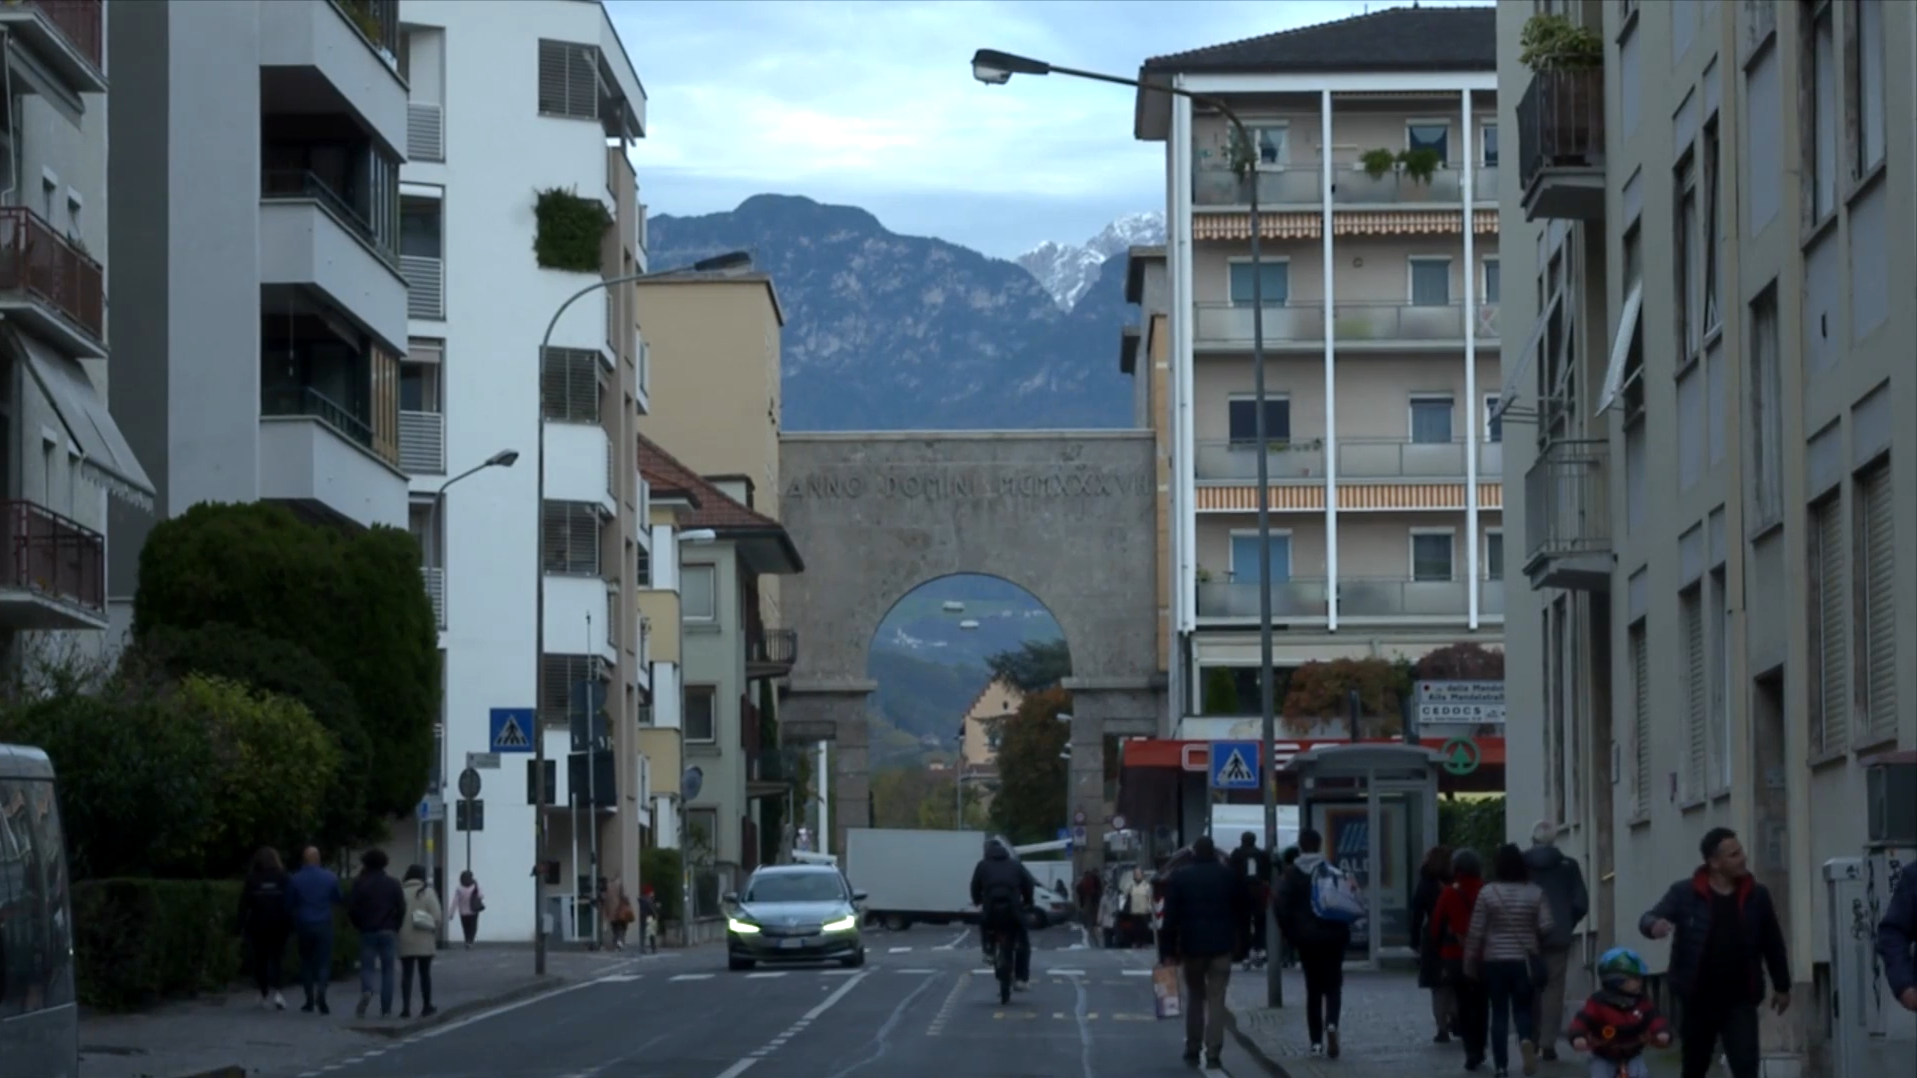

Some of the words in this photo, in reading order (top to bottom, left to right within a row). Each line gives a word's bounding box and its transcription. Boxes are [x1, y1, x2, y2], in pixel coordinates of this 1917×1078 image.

[785, 474, 864, 501] ANNO
[884, 471, 978, 501] DOMINI
[1421, 706, 1482, 716] CEDOCS
[1338, 857, 1370, 872] ALD
